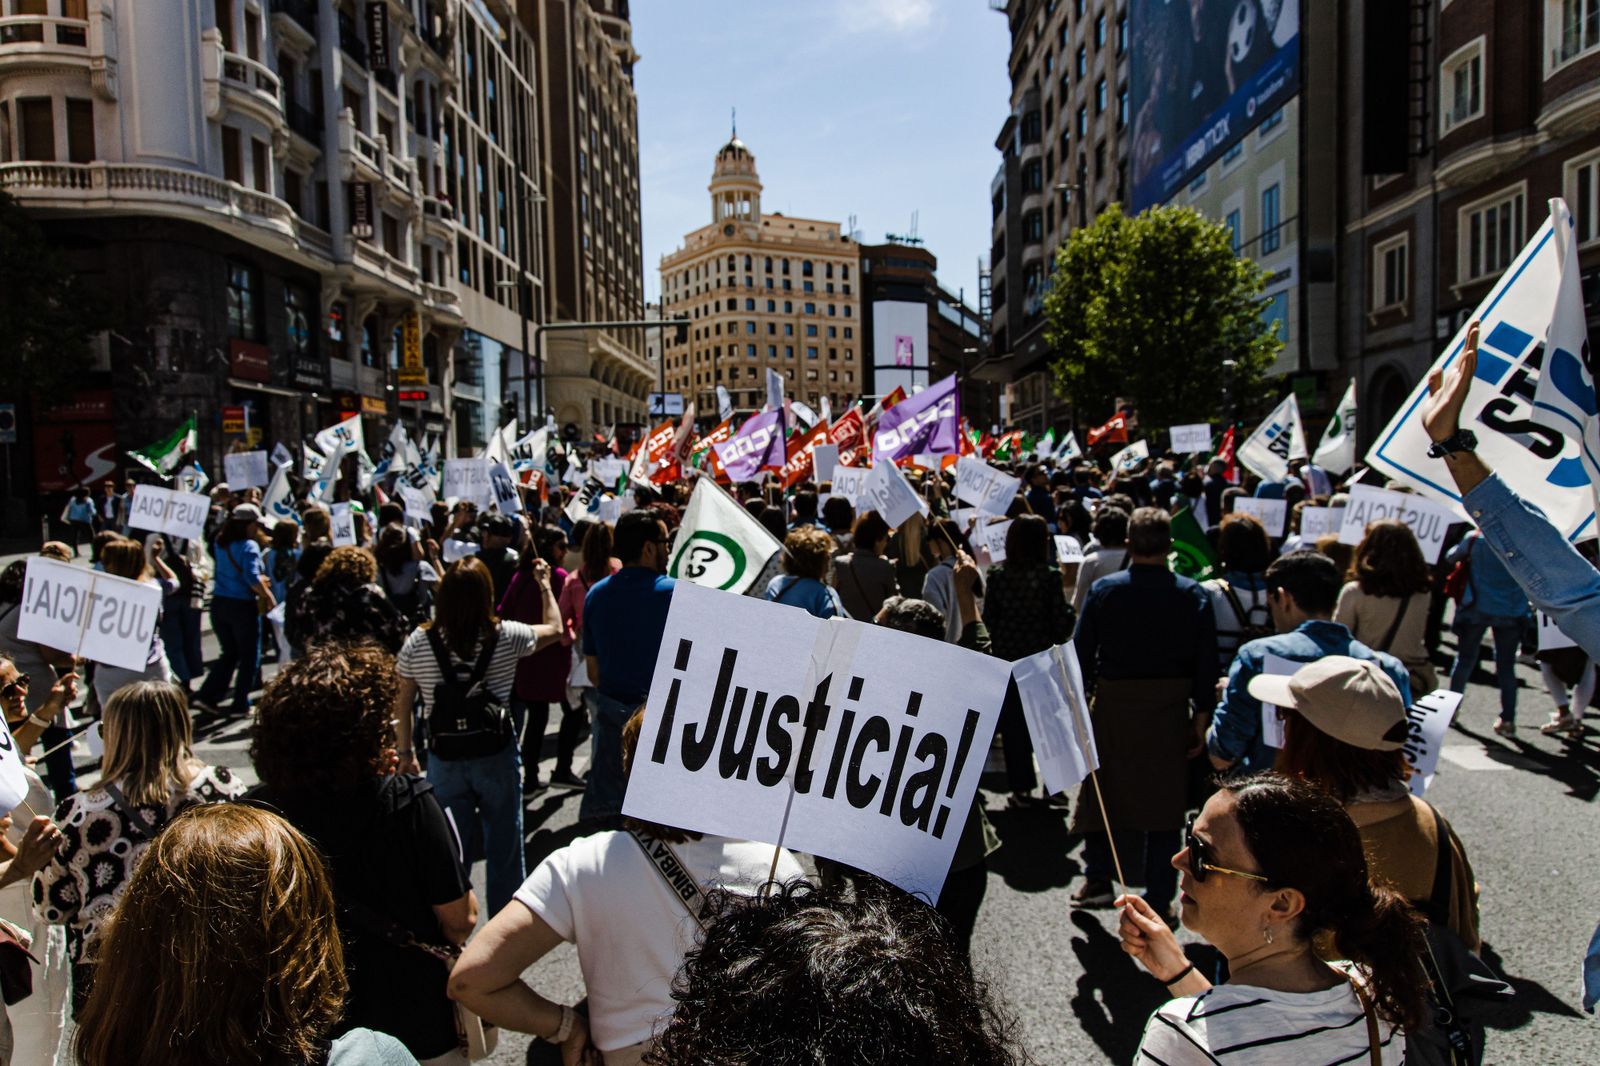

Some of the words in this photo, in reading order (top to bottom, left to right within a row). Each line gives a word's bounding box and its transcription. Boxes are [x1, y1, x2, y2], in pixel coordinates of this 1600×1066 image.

[1479, 324, 1565, 461] ST
[651, 638, 980, 840] ¡Justicia!
[653, 842, 697, 901] BIMBA
